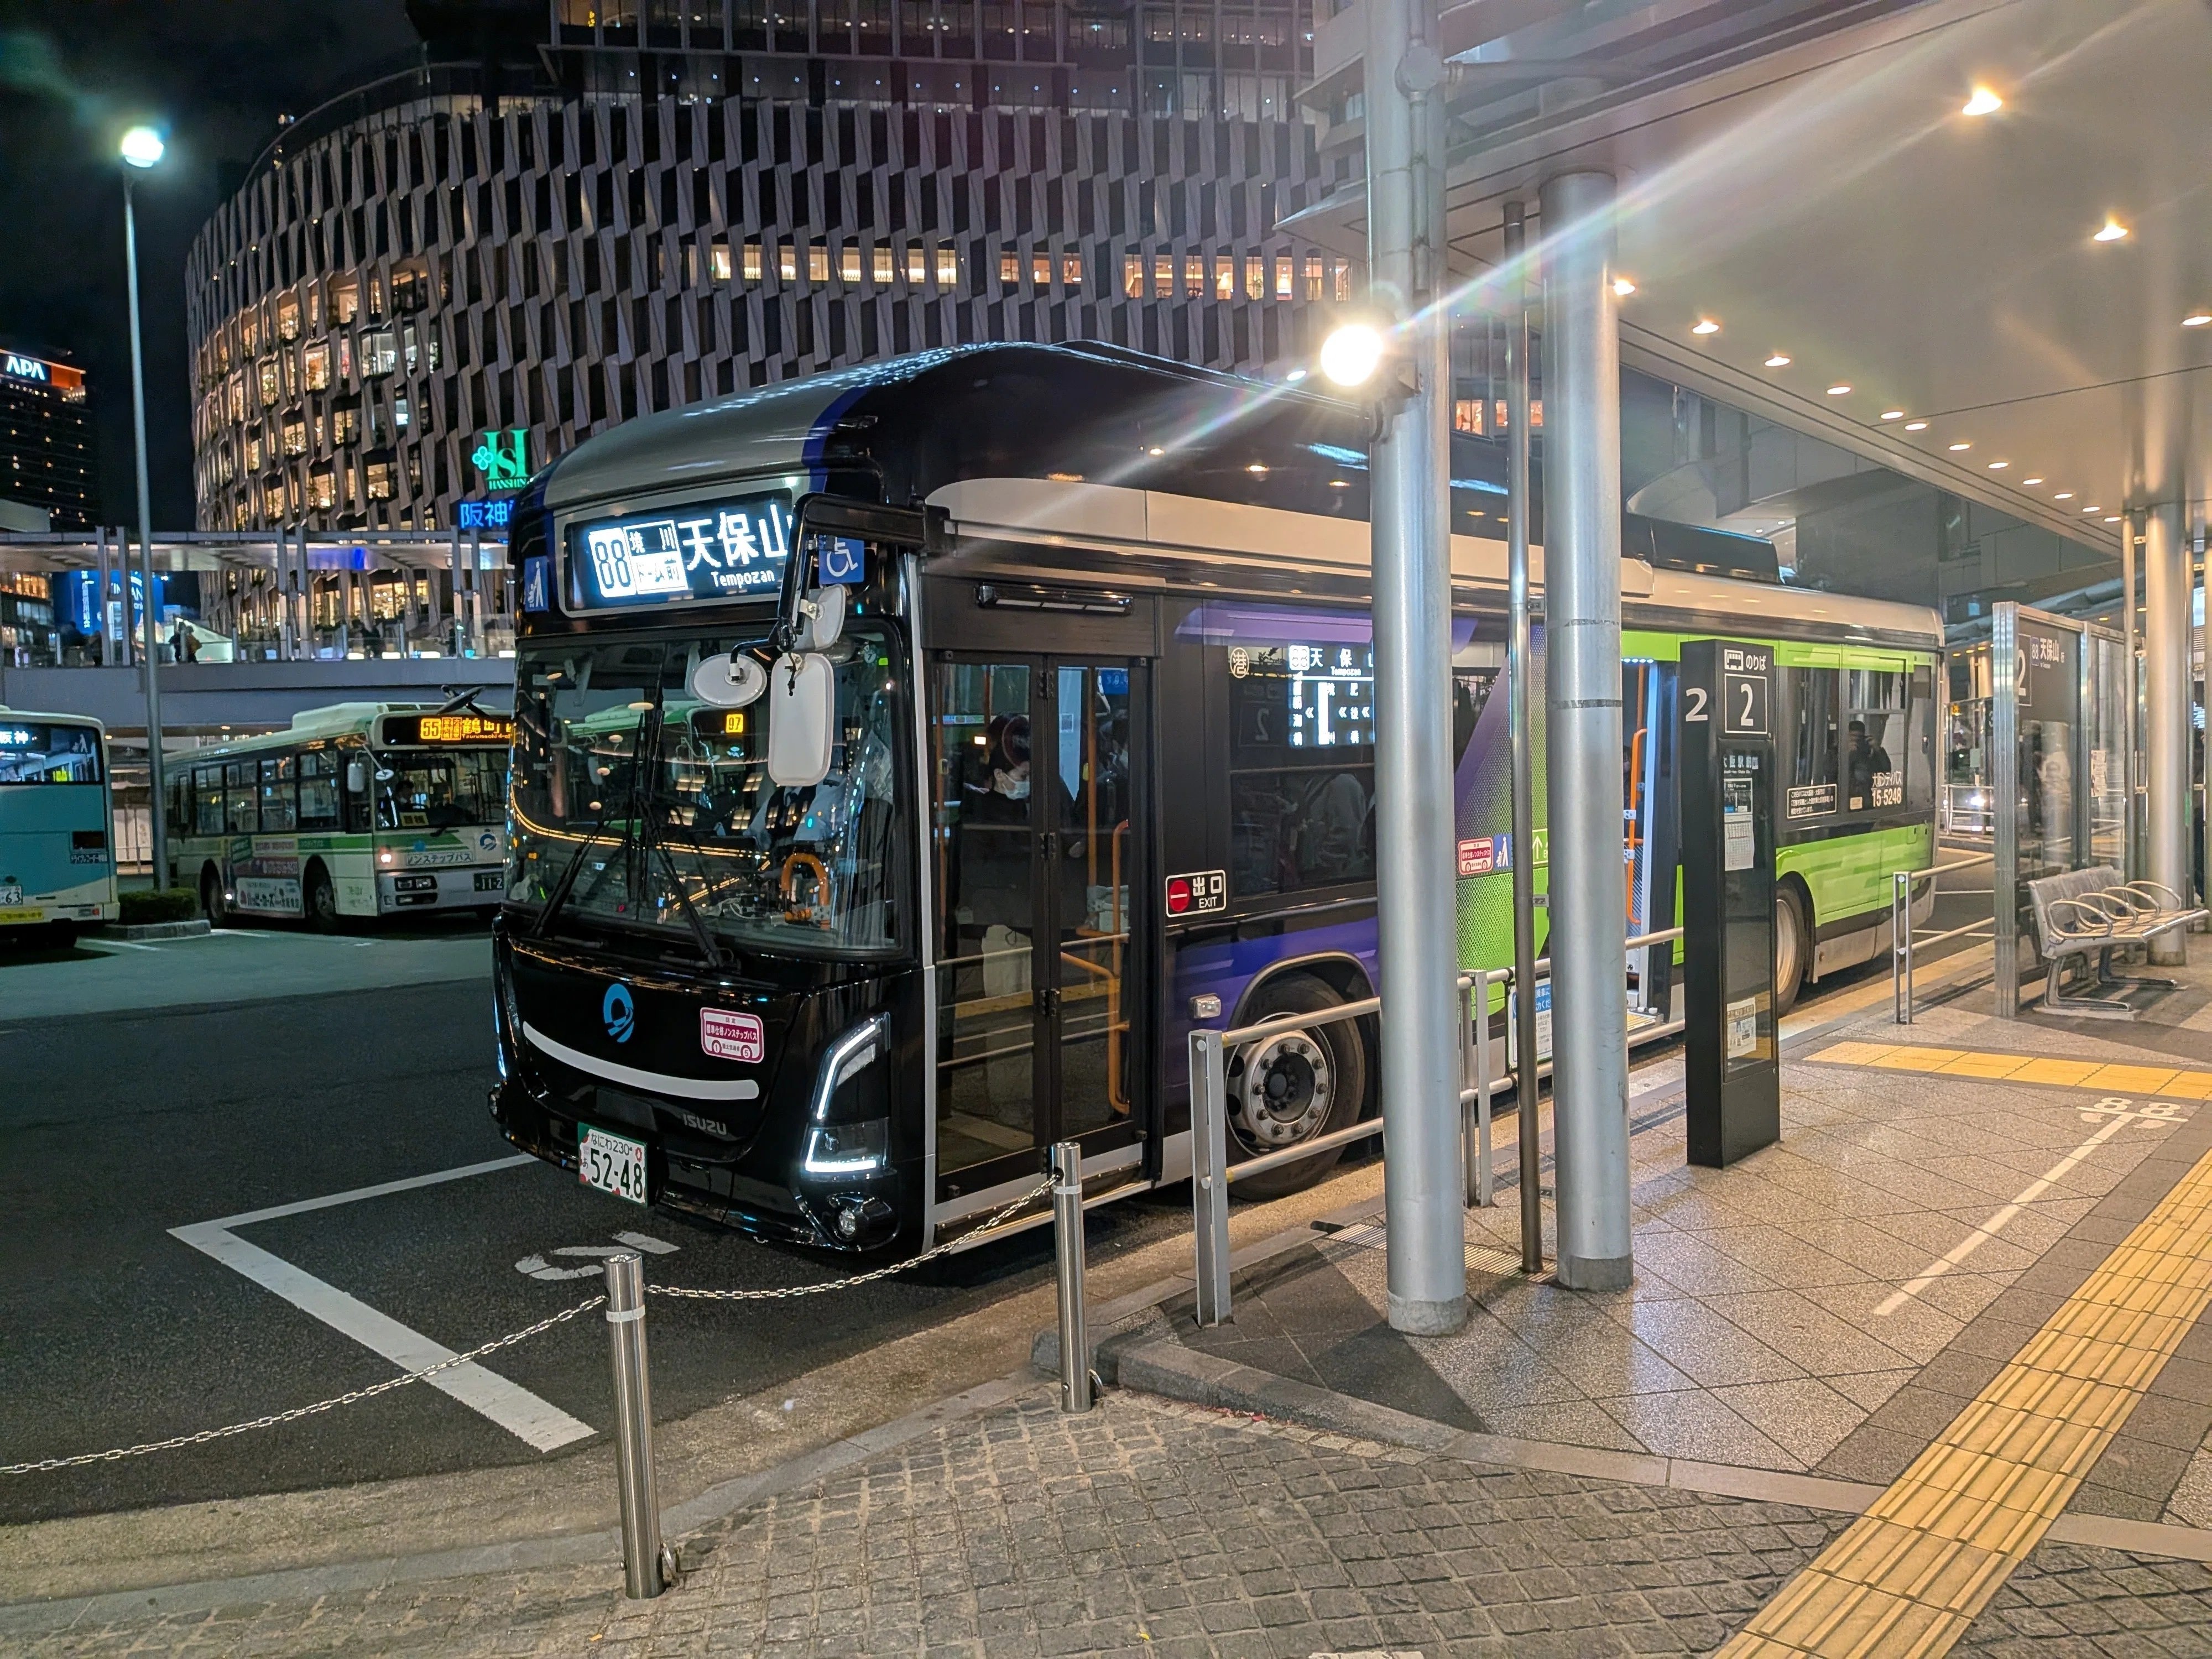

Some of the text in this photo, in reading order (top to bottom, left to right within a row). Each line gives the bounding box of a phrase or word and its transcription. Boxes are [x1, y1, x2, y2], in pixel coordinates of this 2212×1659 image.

[6, 356, 45, 380] APA
[489, 478, 526, 491] HANSHIN
[460, 500, 514, 529] 阪神
[678, 504, 792, 571] 天保山
[595, 539, 631, 589] 88
[711, 570, 775, 588] Tempozan
[2032, 644, 2039, 660] 88
[2040, 638, 2059, 662] 天保山
[1745, 655, 1766, 671] のりば
[1686, 688, 1708, 722] 2
[1740, 684, 1754, 726] 2
[424, 721, 439, 737] 55
[729, 717, 741, 730] 97
[1872, 787, 1902, 807] 15-5248
[408, 853, 472, 864] ノンステップバス
[1193, 876, 1222, 896] 出口
[1199, 896, 1218, 909] EXIT
[2093, 1097, 2180, 1117] 88
[683, 1114, 727, 1135] ISUZU
[591, 1147, 643, 1199] 52-48
